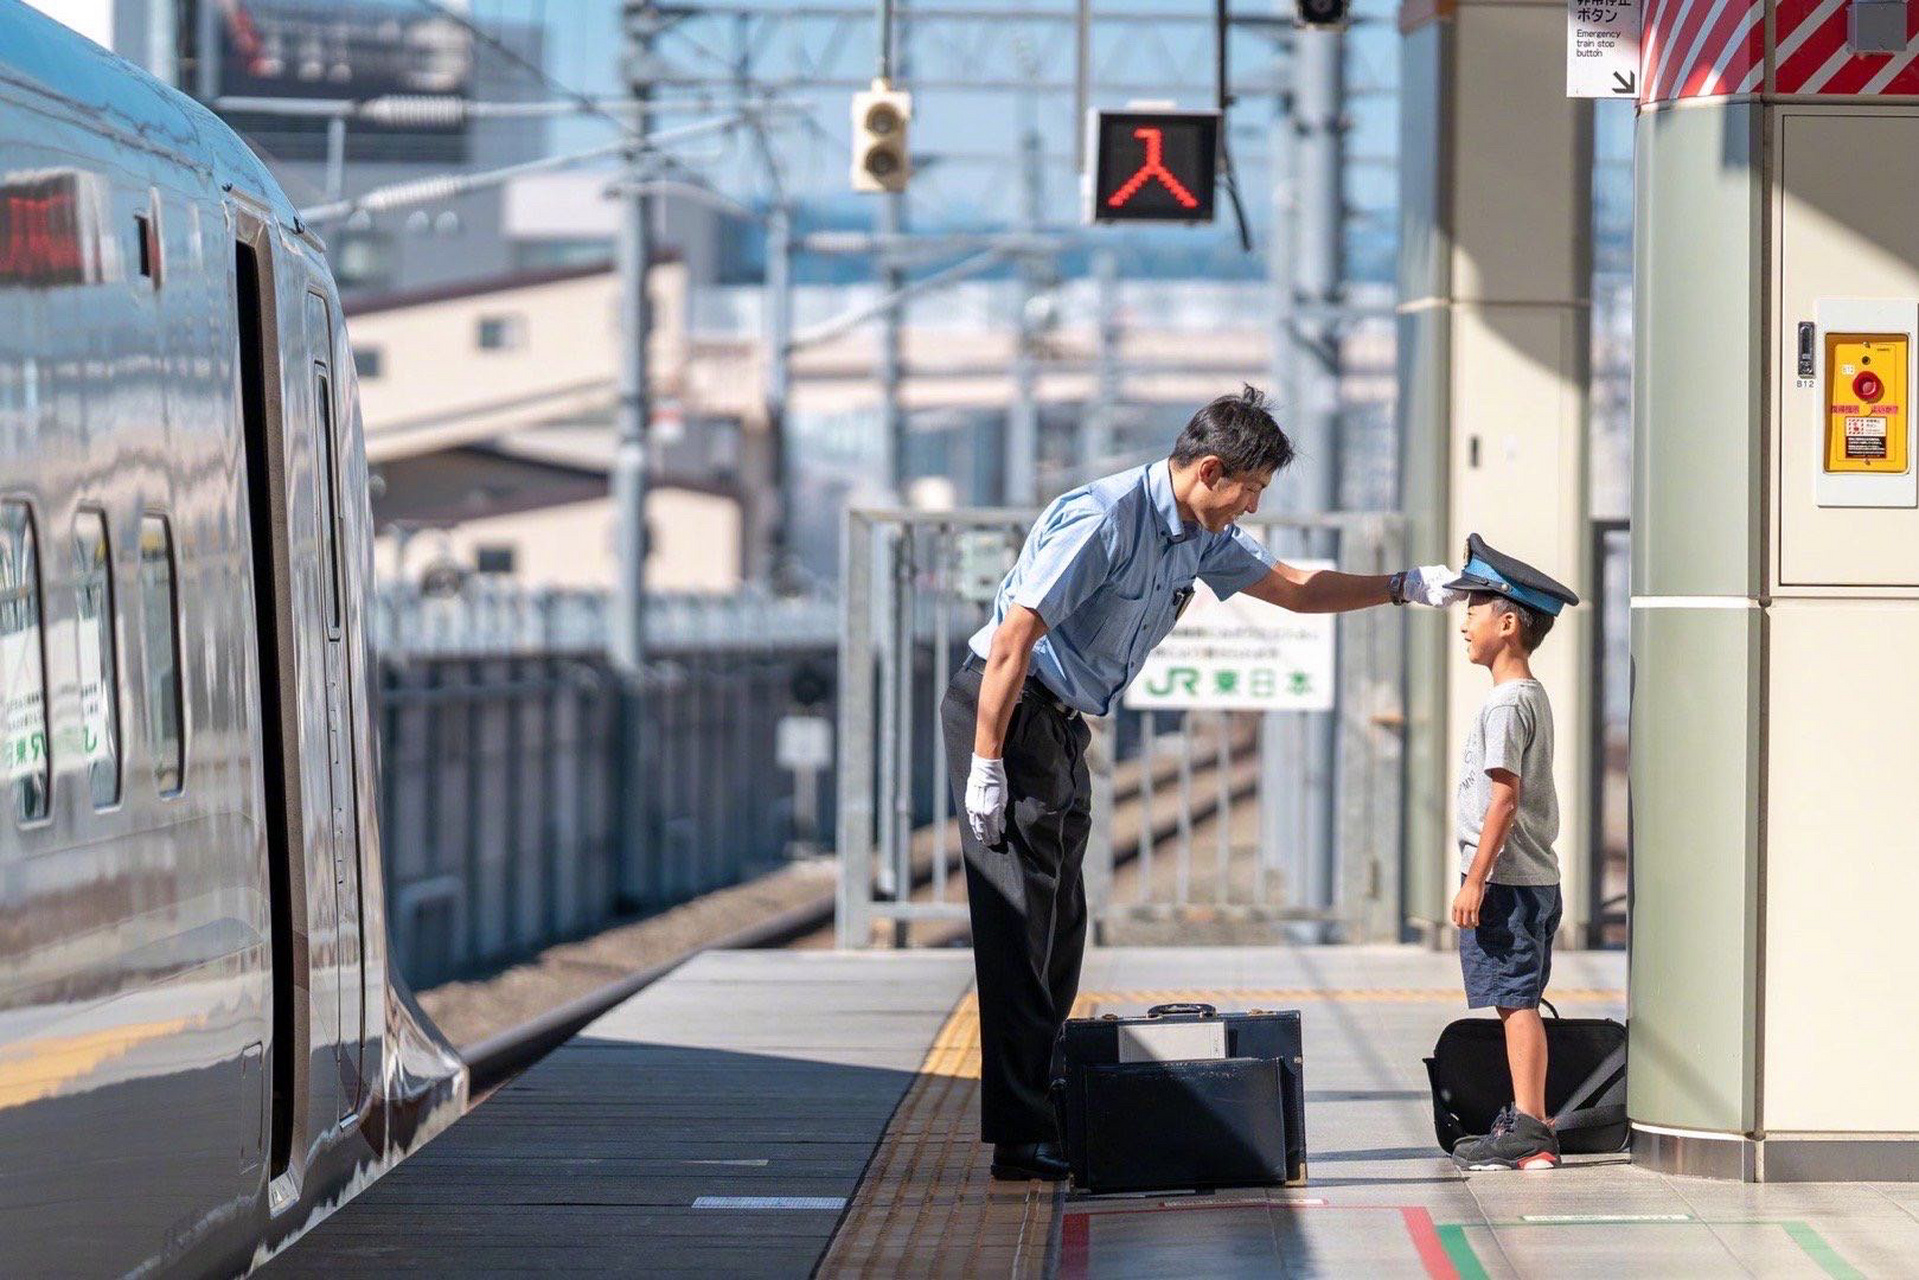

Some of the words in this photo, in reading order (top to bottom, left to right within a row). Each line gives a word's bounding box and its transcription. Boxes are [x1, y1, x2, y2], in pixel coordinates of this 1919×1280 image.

[1577, 8, 1617, 23] ボタン
[1576, 29, 1621, 39] Emergency
[1576, 39, 1595, 47] train
[1597, 40, 1615, 48] stop
[1576, 49, 1603, 57] button
[1796, 379, 1815, 388] B12
